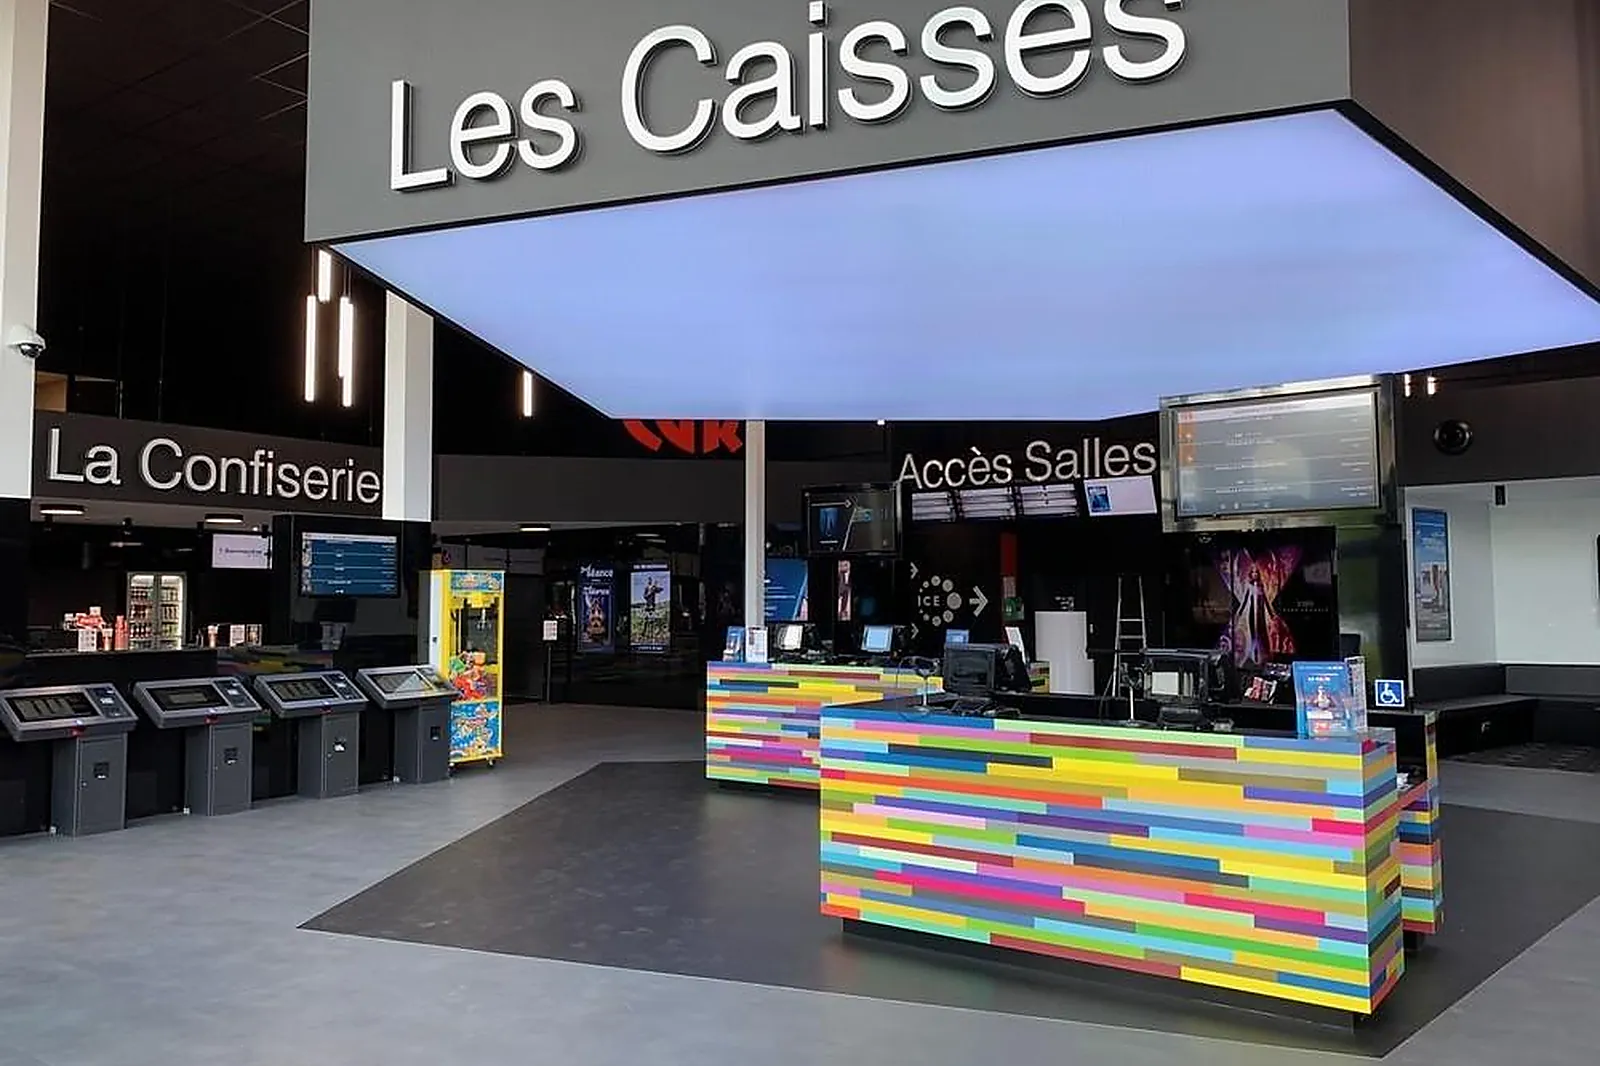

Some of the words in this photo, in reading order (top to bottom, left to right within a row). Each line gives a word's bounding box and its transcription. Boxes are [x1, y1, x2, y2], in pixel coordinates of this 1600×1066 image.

[390, 79, 581, 192] Les
[620, 0, 1188, 155] Caisses
[47, 427, 121, 486] La
[140, 438, 381, 504] Confiserie
[898, 446, 1013, 489] Accès
[1025, 437, 1158, 482] Salles
